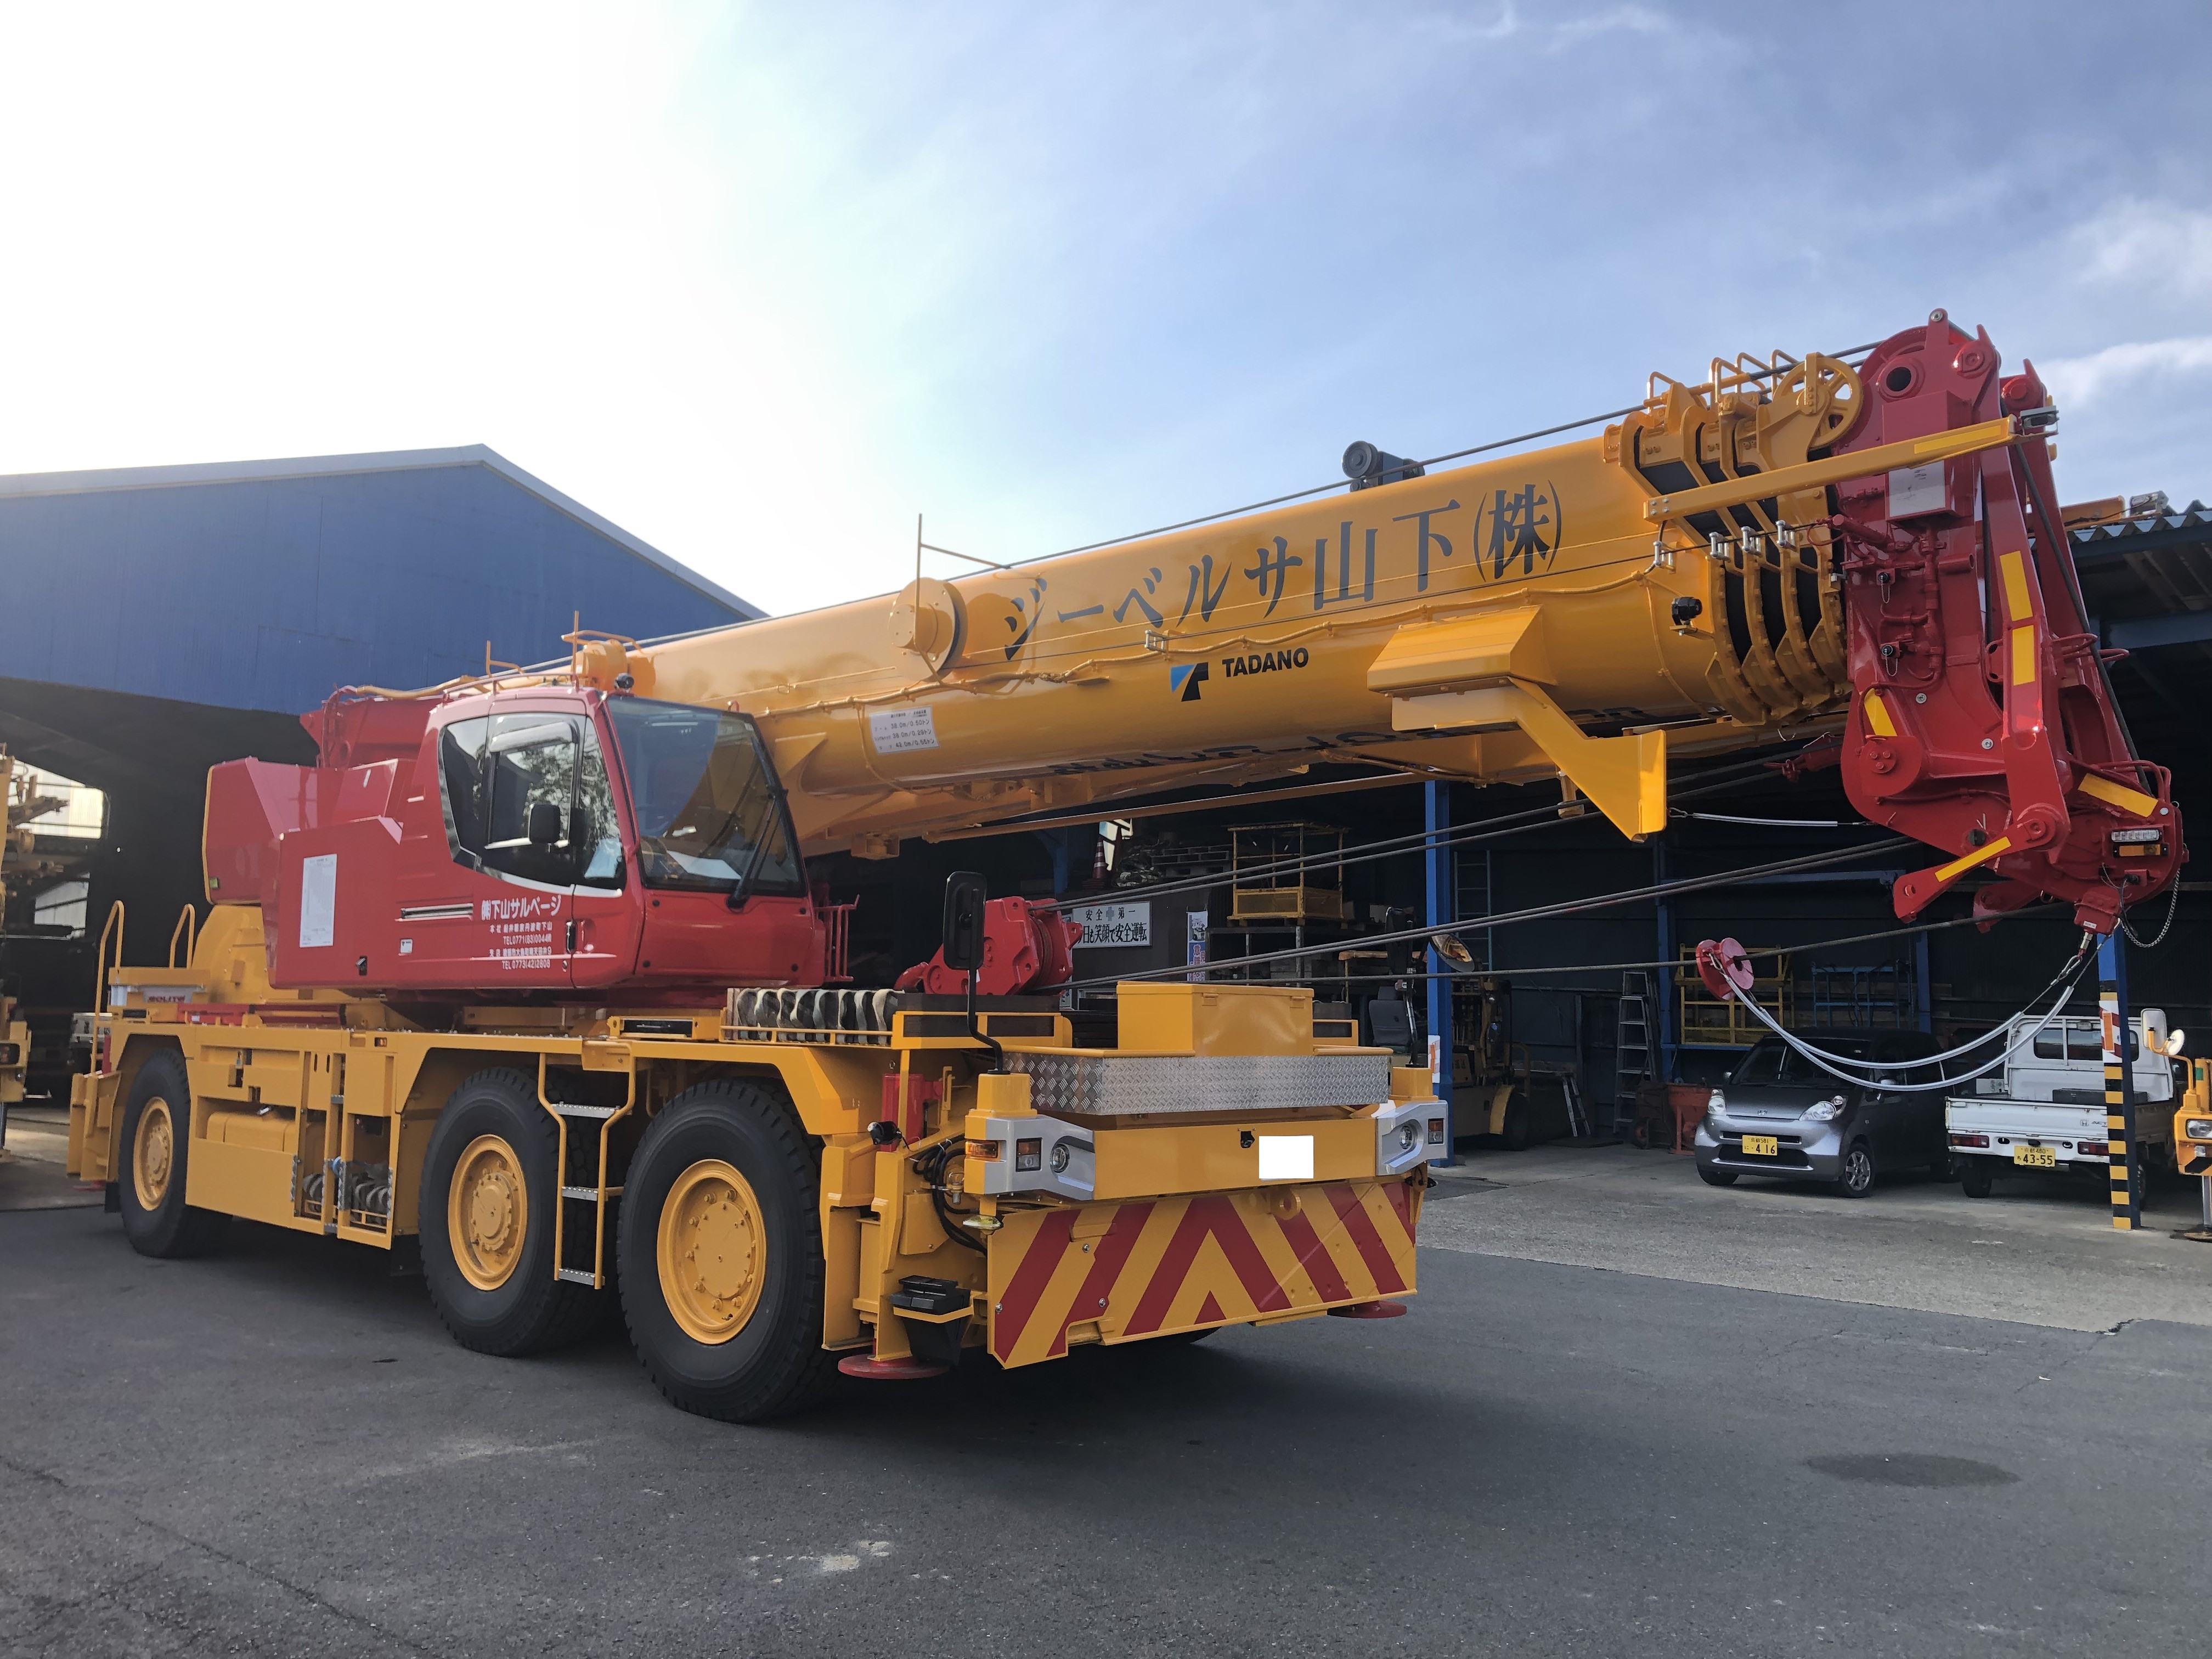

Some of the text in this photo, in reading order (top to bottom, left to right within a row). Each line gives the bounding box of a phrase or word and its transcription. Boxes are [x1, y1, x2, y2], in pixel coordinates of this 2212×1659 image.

[1222, 647, 1309, 678] TADANO
[1086, 907, 1136, 921] 安全 第一
[1077, 922, 1147, 944] 日も笑顔で安全運転
[2023, 1154, 2053, 1165] 43-55
